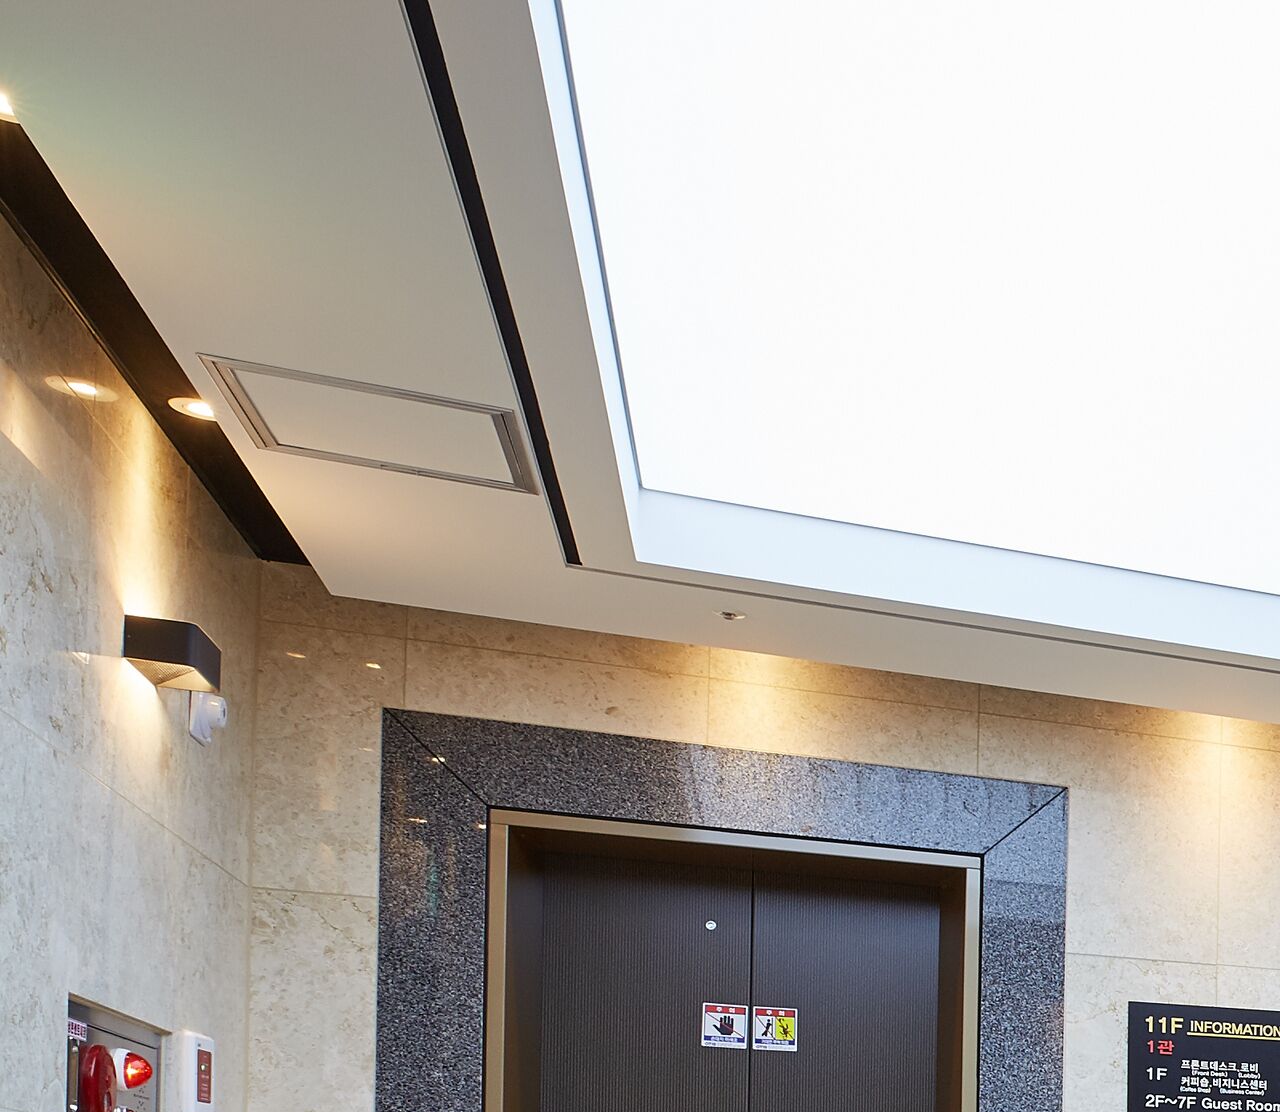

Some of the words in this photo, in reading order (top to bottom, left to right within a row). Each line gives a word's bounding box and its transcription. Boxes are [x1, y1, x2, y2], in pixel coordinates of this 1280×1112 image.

[1145, 1016, 1184, 1034] 11F
[1147, 1039, 1175, 1055] 1관
[1146, 1067, 1168, 1081] 1F
[1145, 1094, 1197, 1109] 2F~7F
[1201, 1097, 1242, 1110] Guest
